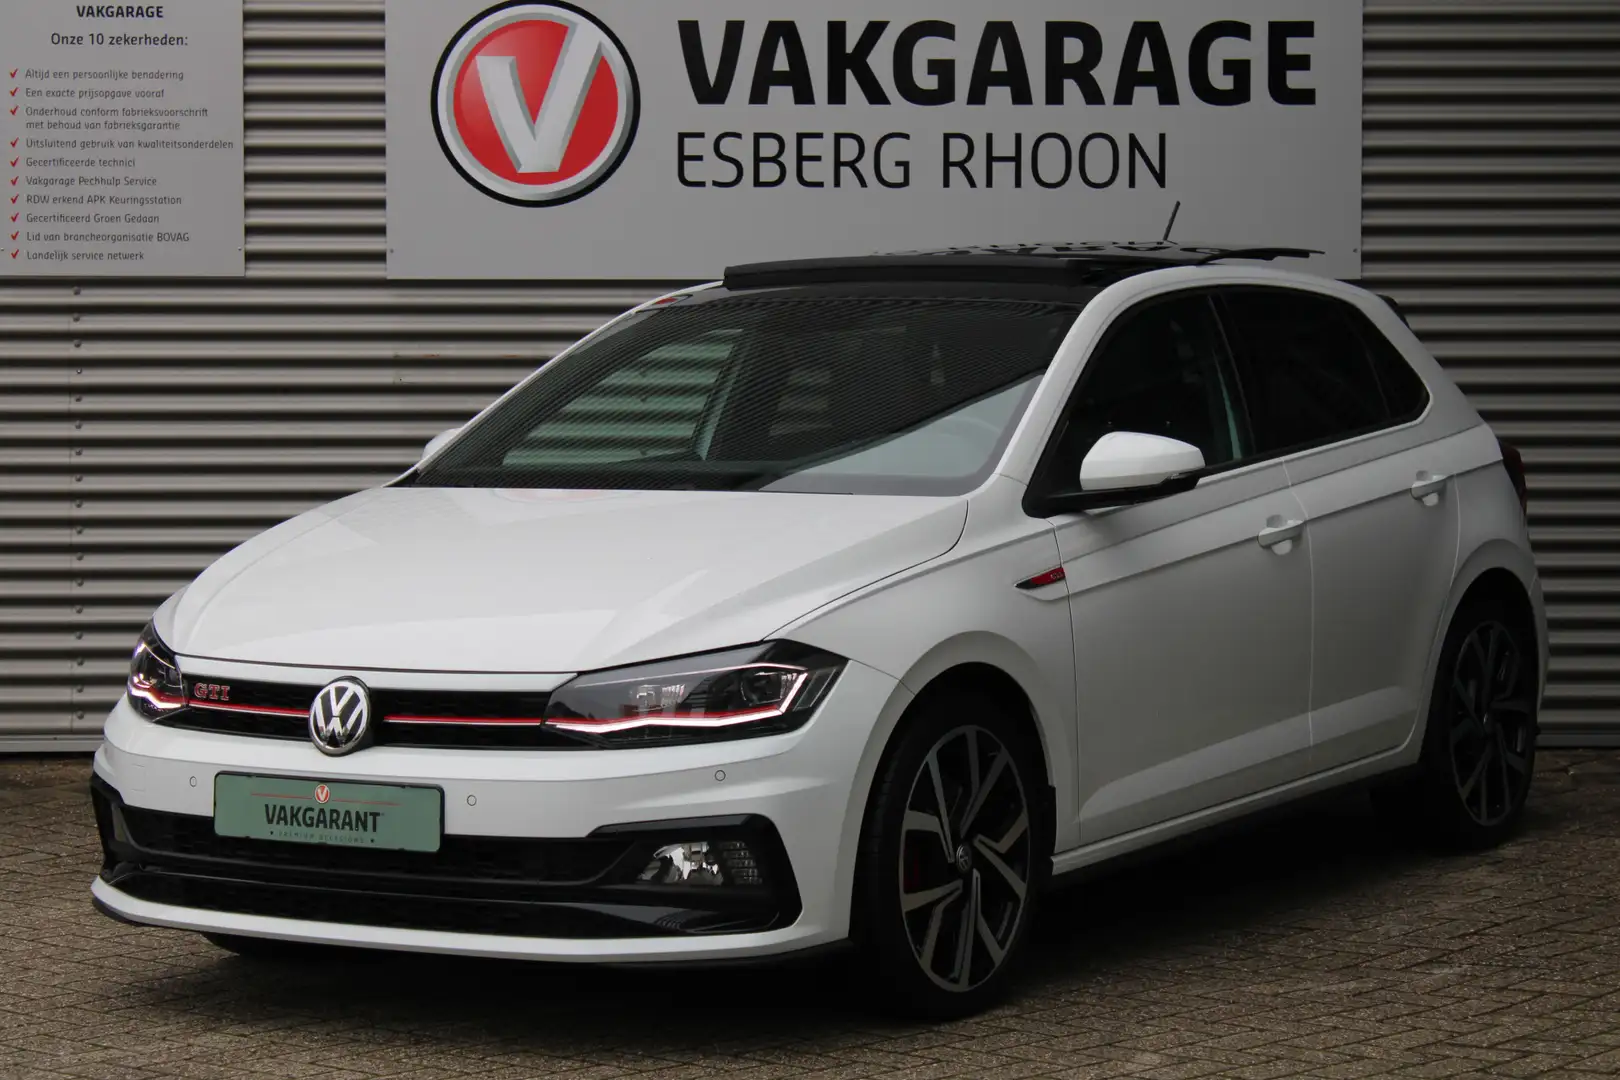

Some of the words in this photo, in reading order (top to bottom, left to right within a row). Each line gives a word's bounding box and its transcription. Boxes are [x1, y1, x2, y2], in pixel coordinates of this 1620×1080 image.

[76, 6, 163, 18] VAKGARAGE
[51, 33, 83, 45] Onze
[89, 33, 104, 45] 10
[109, 33, 188, 46] zekerheden:
[678, 20, 1316, 106] VAKGARAGE
[25, 69, 49, 80] Altijd
[73, 70, 128, 80] persoonlijke
[132, 70, 183, 81] benadering
[26, 88, 42, 97] Een
[46, 89, 75, 97] exacte
[79, 89, 131, 99] prijsopgave
[26, 107, 77, 116] Onderhoud
[80, 108, 119, 116] conform
[26, 121, 44, 129] met
[48, 120, 81, 129] behoud
[104, 120, 180, 131] fabrieksgarantie
[26, 139, 76, 148] Uitsluitend
[80, 140, 115, 150] gebruik
[138, 140, 233, 148] kwaliteitsonderdelen
[26, 158, 95, 167] Gecertificeerde
[99, 158, 135, 167] technici
[678, 132, 910, 188] ESBERG
[943, 132, 1166, 189] RHOON
[26, 176, 75, 187] Vakgarage
[79, 176, 120, 187] Pechhulp
[124, 176, 156, 186] Service
[27, 194, 49, 204] RDW
[53, 196, 83, 204] erkend
[87, 195, 105, 204] APK
[109, 196, 181, 206] Keuringsstation
[27, 213, 90, 223] Gecertificeerd
[94, 214, 121, 223] Groen
[125, 214, 159, 223] Gedaan
[27, 232, 40, 241] Lid
[64, 233, 153, 243] brancheorganisatie
[157, 232, 189, 241] BOVAG
[27, 250, 68, 261] Landelijk
[108, 252, 143, 260] netwerk
[194, 683, 230, 701] GTI
[264, 803, 381, 833] VAKGARANT
